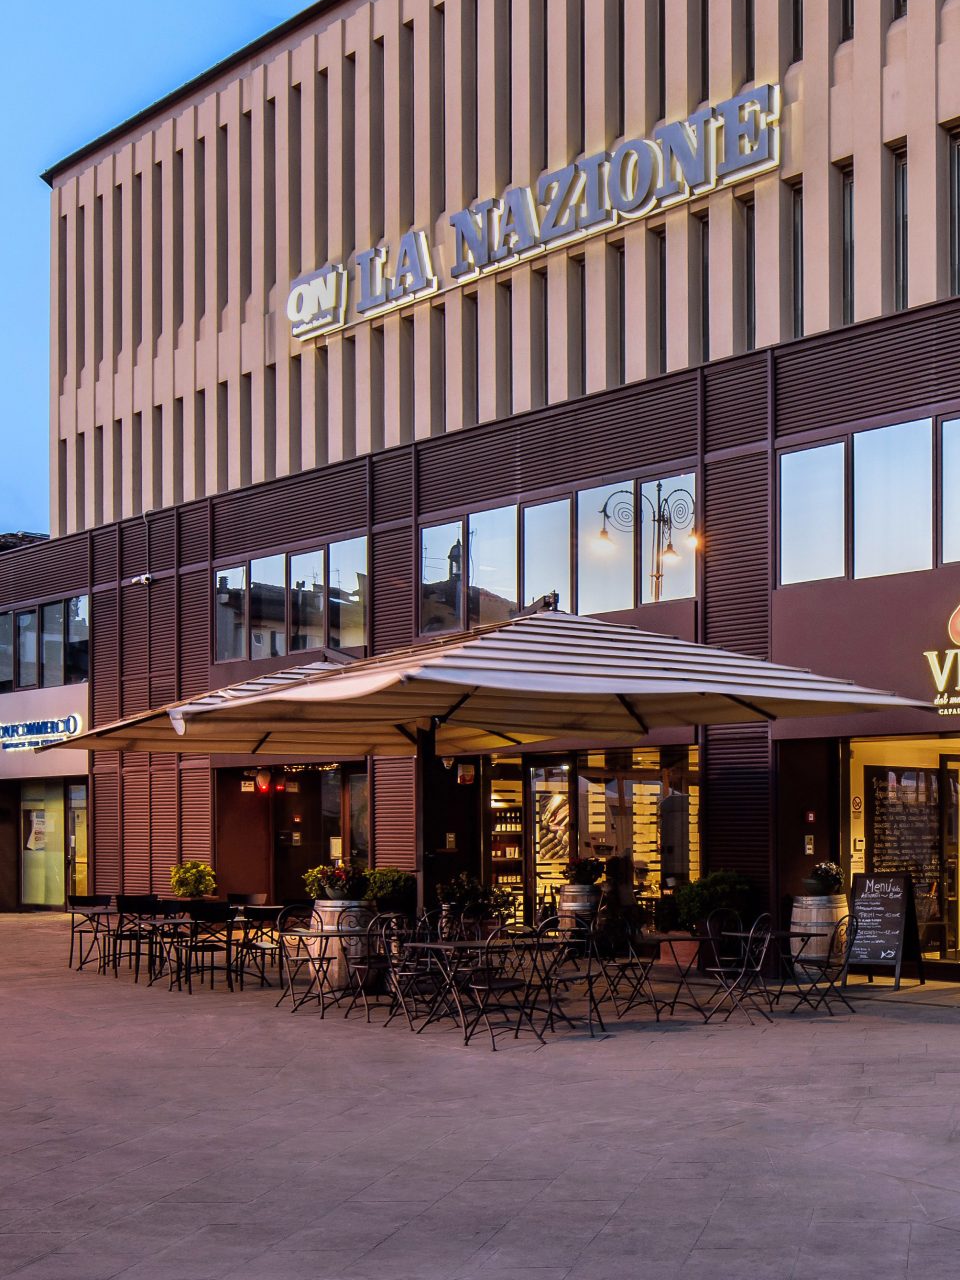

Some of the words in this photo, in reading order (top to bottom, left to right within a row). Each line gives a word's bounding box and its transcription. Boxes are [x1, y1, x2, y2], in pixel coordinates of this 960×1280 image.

[287, 270, 339, 323] QN
[356, 230, 432, 315] LA
[450, 84, 776, 280] NAZIONE
